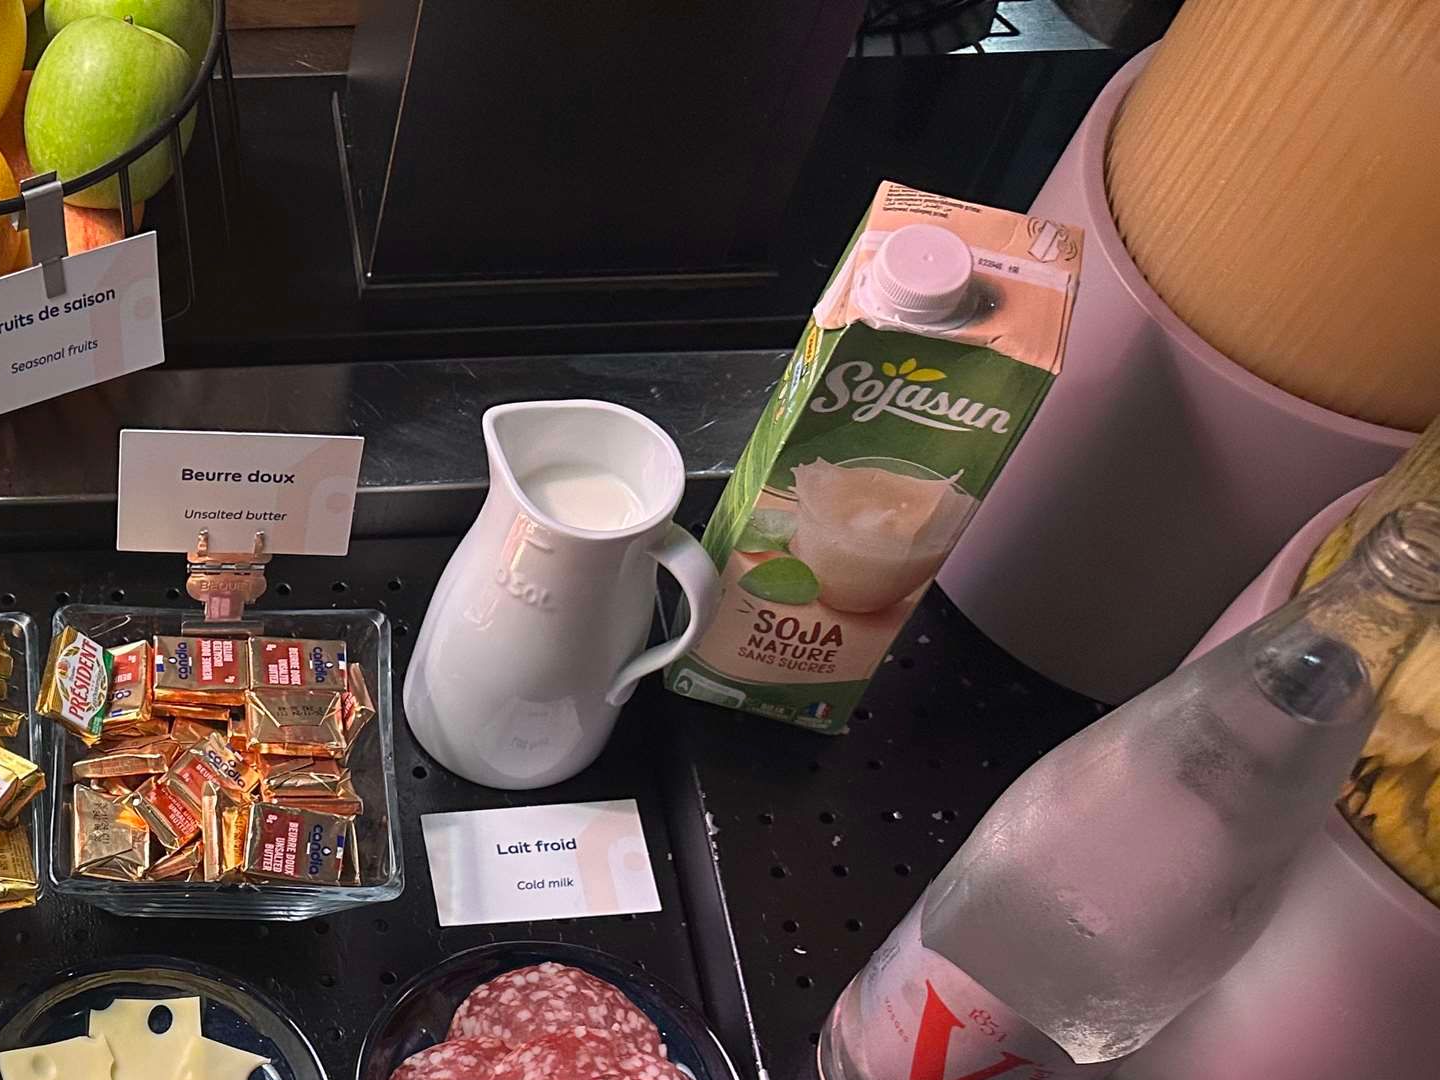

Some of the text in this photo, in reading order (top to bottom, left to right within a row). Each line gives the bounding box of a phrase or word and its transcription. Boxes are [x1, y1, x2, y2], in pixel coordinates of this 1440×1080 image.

[38, 304, 60, 321] de
[64, 287, 116, 314] saison
[11, 338, 98, 374] Seasonal fruits
[810, 360, 1010, 434] Sojasun
[181, 468, 295, 484] Beurre doux
[184, 509, 287, 522] Unsalted butter
[754, 609, 843, 648] SOJA
[738, 646, 836, 674] SANS SUCRES
[747, 634, 838, 663] NATURE
[68, 638, 98, 720] PRÉSIDENT
[262, 844, 274, 872] BUTTER
[273, 837, 286, 872] UNSALTED
[284, 822, 299, 876] BEURRE DOUX
[308, 824, 324, 875] candia
[496, 838, 577, 856] Lait froid
[517, 878, 574, 890] Cold milk
